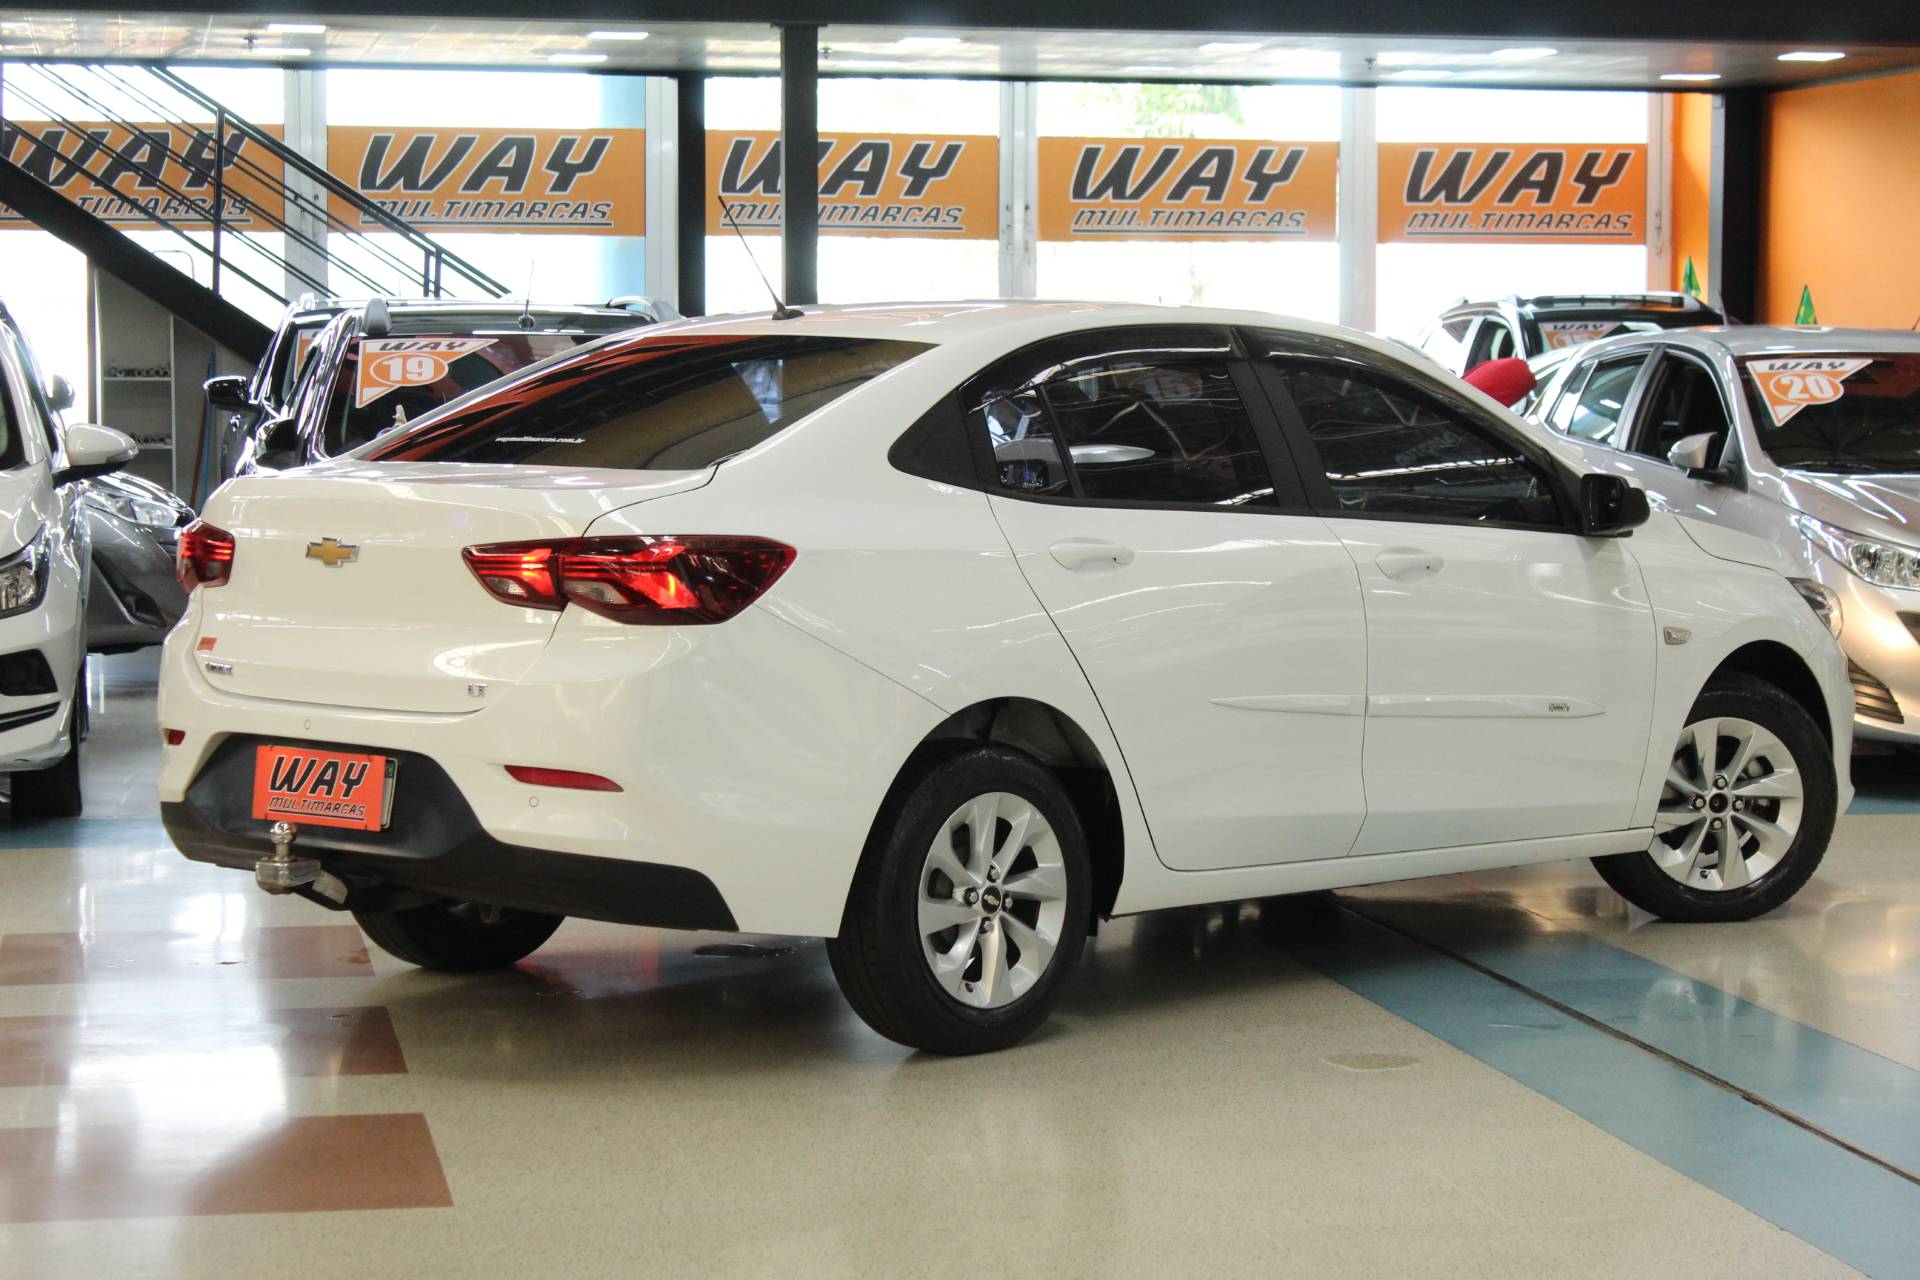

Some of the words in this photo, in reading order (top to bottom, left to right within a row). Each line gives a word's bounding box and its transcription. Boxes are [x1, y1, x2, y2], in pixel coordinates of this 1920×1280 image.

[358, 133, 614, 194] WAY
[719, 137, 966, 200] WAY
[1070, 144, 1308, 204] WAY
[1404, 148, 1634, 207] WAY
[360, 199, 614, 221] MULTIMARCAS
[721, 203, 965, 225] MUIMARCAS
[1071, 207, 1308, 228] MULTIMARCAS
[1406, 211, 1634, 231] MULTIMARCAS
[379, 341, 468, 352] WAY
[382, 356, 435, 382] 19
[1767, 362, 1846, 371] WAY
[1780, 375, 1835, 399] 20
[268, 755, 369, 800] WAY
[269, 797, 366, 817] MULTIMARCAS
